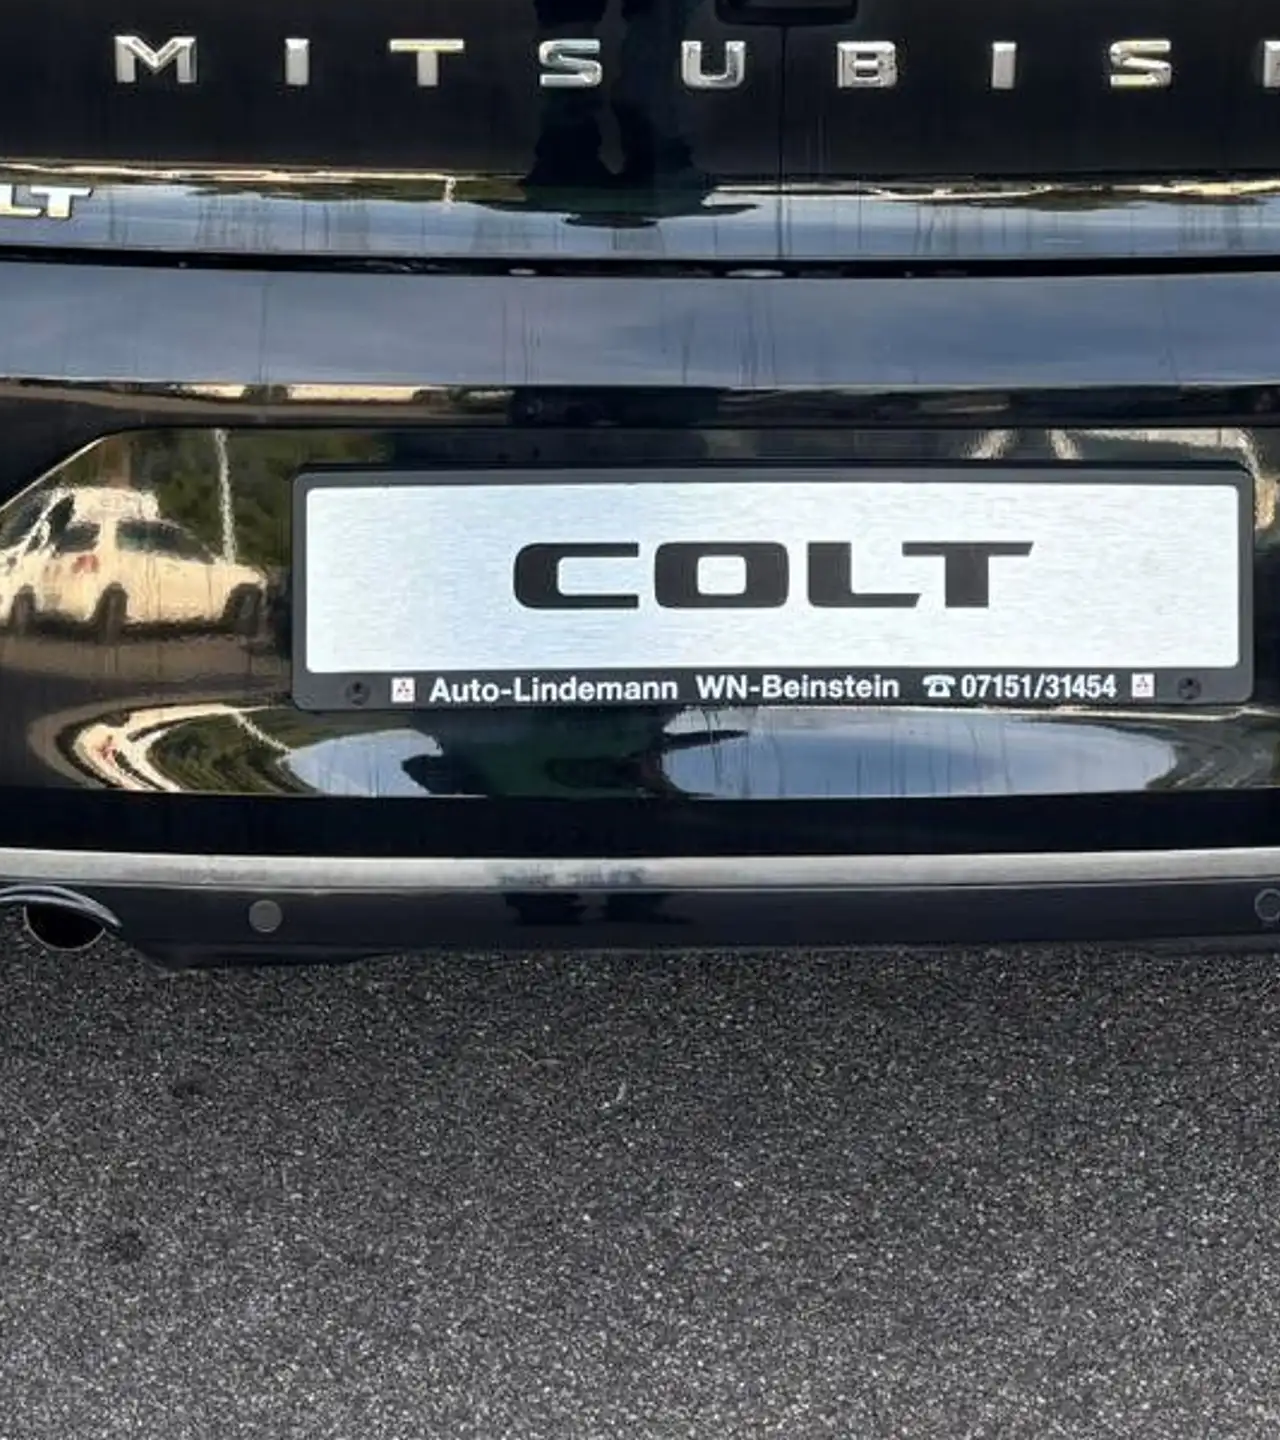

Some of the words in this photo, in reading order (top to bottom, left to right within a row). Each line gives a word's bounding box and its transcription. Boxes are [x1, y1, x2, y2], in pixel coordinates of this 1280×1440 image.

[512, 541, 1034, 610] COLT
[428, 676, 679, 704] Auto-Lindemann
[695, 674, 900, 699] WN-Beinstein
[961, 673, 1117, 699] 07151/31454
